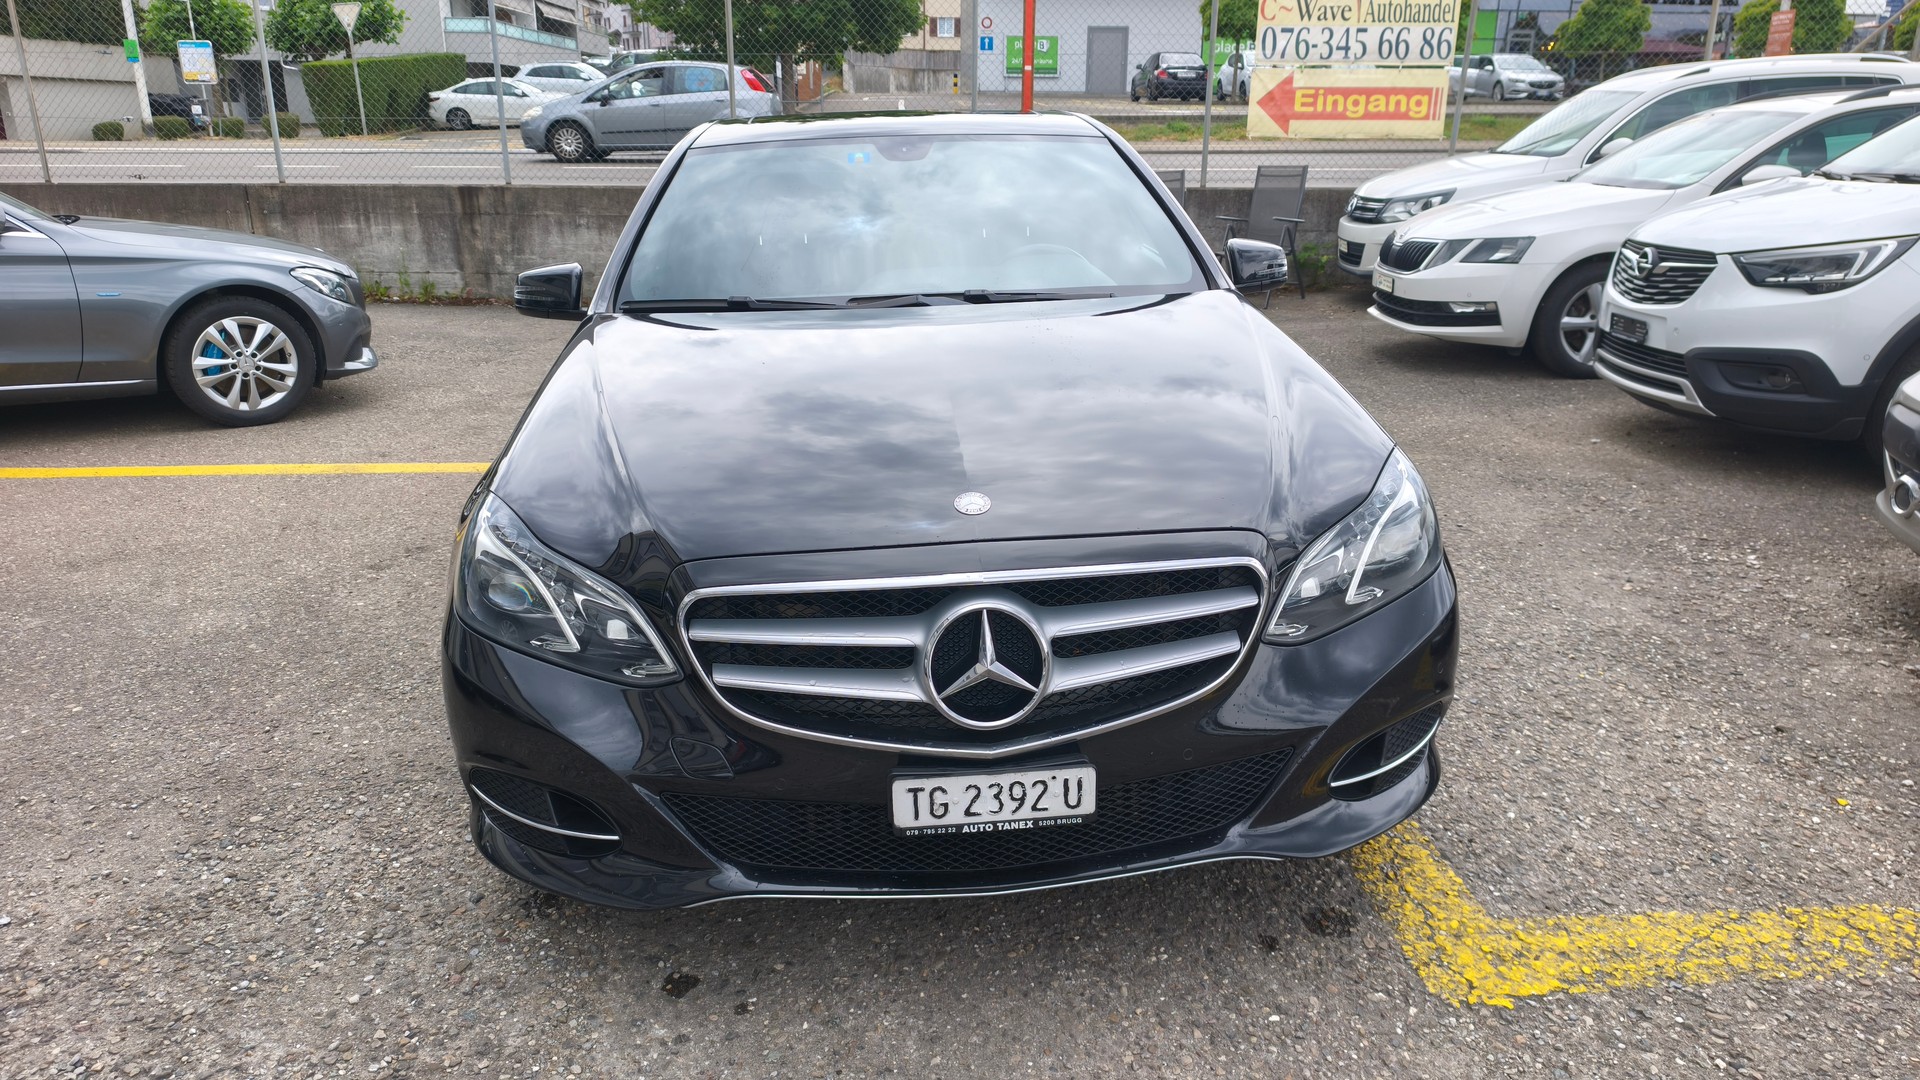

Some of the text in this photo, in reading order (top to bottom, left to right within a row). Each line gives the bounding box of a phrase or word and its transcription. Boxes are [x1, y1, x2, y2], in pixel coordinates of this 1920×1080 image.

[1363, 0, 1456, 23] Autohandel
[1261, 26, 1453, 60] 076-345 66 86
[1294, 89, 1429, 118] Eingang
[906, 775, 1084, 821] TG 2392 U
[962, 823, 994, 833] AUTO
[996, 820, 1034, 831] TANEX
[1056, 817, 1082, 825] BRUGG
